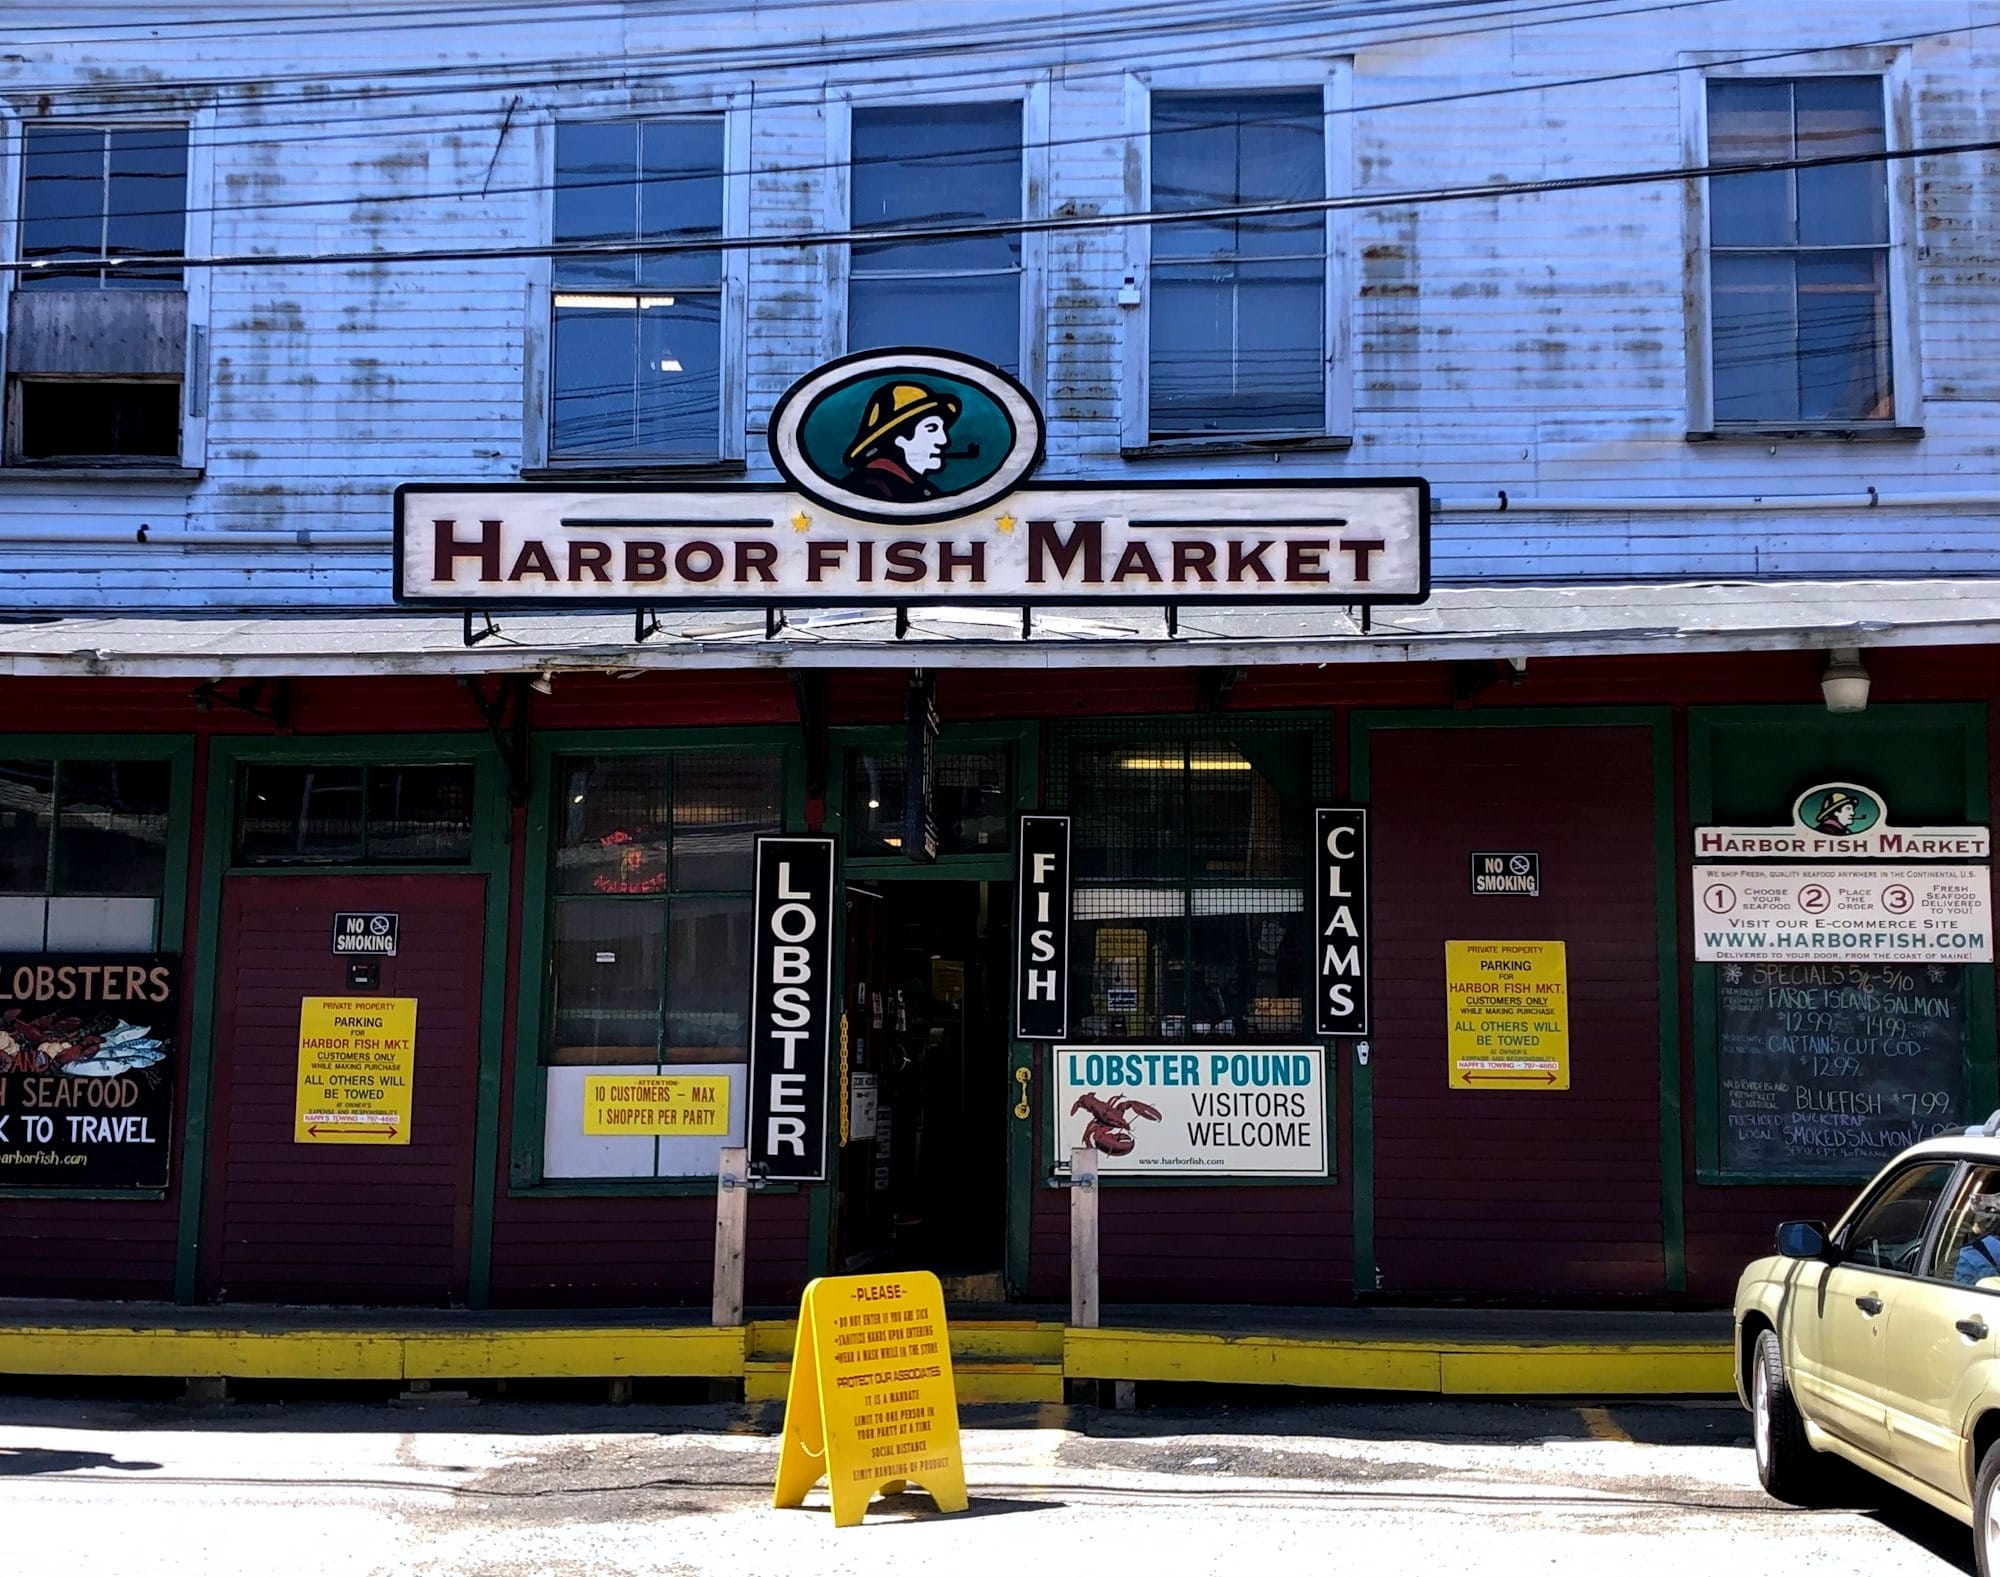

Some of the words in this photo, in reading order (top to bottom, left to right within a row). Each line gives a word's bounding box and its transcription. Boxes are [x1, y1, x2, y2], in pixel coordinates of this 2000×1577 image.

[431, 519, 779, 583] HARBOR
[805, 539, 987, 583] FISH
[1025, 519, 1386, 584] MARKET
[1701, 833, 1806, 852] HARBOR
[1814, 839, 1868, 853] FISH
[1880, 834, 1985, 853] MARKET
[1485, 858, 1504, 874] NO
[1769, 871, 1801, 879] QUALITY
[1837, 871, 1878, 879] ANYWHERE
[1906, 870, 1958, 879] CONTINENTAL
[1476, 875, 1536, 891] SMOKING
[1715, 890, 1724, 909] 1
[1744, 888, 1789, 896] CHOOSE
[1805, 889, 1824, 907] 2
[1838, 888, 1872, 896] PLACE
[1889, 890, 1907, 908] 3
[1926, 892, 1976, 900] SEAFOOD
[1921, 899, 1982, 907] DELIVERED
[1930, 907, 1944, 915] TO
[1947, 907, 1974, 915] YOU!
[346, 918, 365, 934] NO
[1027, 853, 1057, 1001] FISH
[1323, 826, 1361, 1016] CLAMS
[1728, 918, 1771, 929] VISIT
[1775, 919, 1809, 929] OUR
[1815, 919, 1917, 929] E-COMMERCE
[1923, 919, 1959, 929] SITE
[336, 934, 394, 951] SMOKING
[1703, 932, 1984, 949] WWW.HARBORFISH.COM
[1467, 946, 1498, 954] PRIVATE
[1501, 946, 1544, 954] PROPERTY
[1716, 951, 1769, 959] DELIVERED
[1873, 952, 1891, 960] THE
[1940, 952, 1973, 960] MAINE!
[1480, 960, 1532, 971] PARKING
[1752, 963, 1845, 986] SPECIALS
[1449, 982, 1499, 993] HARBOR
[1504, 983, 1531, 993] FISH
[1535, 983, 1565, 994] MKT.
[322, 1002, 352, 1010] PRIVATE
[355, 1002, 396, 1011] PROPERTY
[767, 862, 817, 1156] LOBSTER
[1465, 996, 1522, 1005] CUSTOMERS
[1525, 996, 1549, 1006] ONLY
[1768, 986, 1819, 1010] FAROE
[1824, 988, 1881, 1013] ISLAND
[1882, 992, 1950, 1018] SALMON
[334, 1016, 383, 1028] PARKING
[1454, 1021, 1475, 1032] ALL
[1480, 1021, 1529, 1032] OTHERS
[1533, 1022, 1562, 1032] WILL
[350, 1029, 366, 1037] FOR
[1476, 1035, 1492, 1046] BE
[1497, 1035, 1540, 1046] TOWED
[302, 1038, 350, 1049] HARBOR
[354, 1038, 380, 1050] FISH
[384, 1039, 410, 1050] MKT.
[1844, 1036, 1879, 1056] CUT
[1883, 1038, 1921, 1057] COD
[317, 1051, 371, 1061] CUSTOMERS
[374, 1052, 396, 1062] ONLY
[311, 1062, 332, 1070] WHILE
[334, 1063, 362, 1071] MAKING
[364, 1063, 401, 1071] PURCHASE
[1069, 1054, 1200, 1087] LOBSTER
[1210, 1054, 1312, 1087] POUND
[304, 1074, 324, 1086] ALL
[329, 1075, 375, 1086] OTHERS
[380, 1075, 406, 1087] WILL
[21, 1077, 139, 1109] SEAFOOD
[324, 1088, 339, 1099] BE
[344, 1089, 385, 1100] TOWED
[595, 1086, 606, 1102] 10
[610, 1086, 670, 1102] CUSTOMERS
[691, 1086, 716, 1103] MAX
[1796, 1085, 1881, 1114] BLUEFISH
[1191, 1092, 1306, 1118] VISITORS
[606, 1108, 654, 1125] SHOPPER
[658, 1109, 677, 1125] PER
[682, 1109, 716, 1125] PARTY
[1791, 1111, 1867, 1127] DUCKTRAP
[20, 1115, 54, 1144] TO
[66, 1115, 156, 1144] TRAVEL
[1187, 1122, 1312, 1147] WELCOME
[1782, 1125, 1847, 1147] SMOKED
[1846, 1129, 1913, 1148] SALMON
[1138, 1156, 1225, 1166] www.harborfish.com
[839, 1316, 848, 1328] DO
[849, 1314, 861, 1327] NOT
[863, 1313, 881, 1326] ENTER
[890, 1311, 902, 1323] YOU
[903, 1310, 913, 1322] ARE
[915, 1308, 929, 1320] SICK
[867, 1330, 887, 1343] HANDS
[888, 1328, 904, 1341] UPON
[906, 1325, 933, 1338] ENTERING
[863, 1349, 879, 1361] MASK
[880, 1346, 899, 1359] WHILE
[899, 1346, 907, 1358] IN
[908, 1344, 919, 1356] THE
[920, 1342, 938, 1355] STORE
[836, 1374, 873, 1388] PROTECT
[875, 1371, 892, 1384] OUR
[893, 1366, 941, 1382] ASSOCIATES
[864, 1395, 872, 1406] IT
[874, 1394, 881, 1405] IS
[890, 1389, 919, 1403] MANDATE
[854, 1414, 873, 1427] LIMIT
[875, 1412, 883, 1424] TO
[885, 1411, 898, 1423] ONE
[900, 1407, 925, 1420] PERSON
[927, 1406, 935, 1417] IN
[857, 1428, 875, 1440] YOUR
[877, 1425, 897, 1437] PARTY
[899, 1423, 907, 1435] AT
[915, 1420, 931, 1433] TIME
[871, 1445, 894, 1459] SOCIAL
[896, 1440, 927, 1455] DISTANCE
[853, 1468, 872, 1481] LIMIT
[875, 1463, 908, 1478] HANDLING
[920, 1457, 949, 1471] PRODUCT
